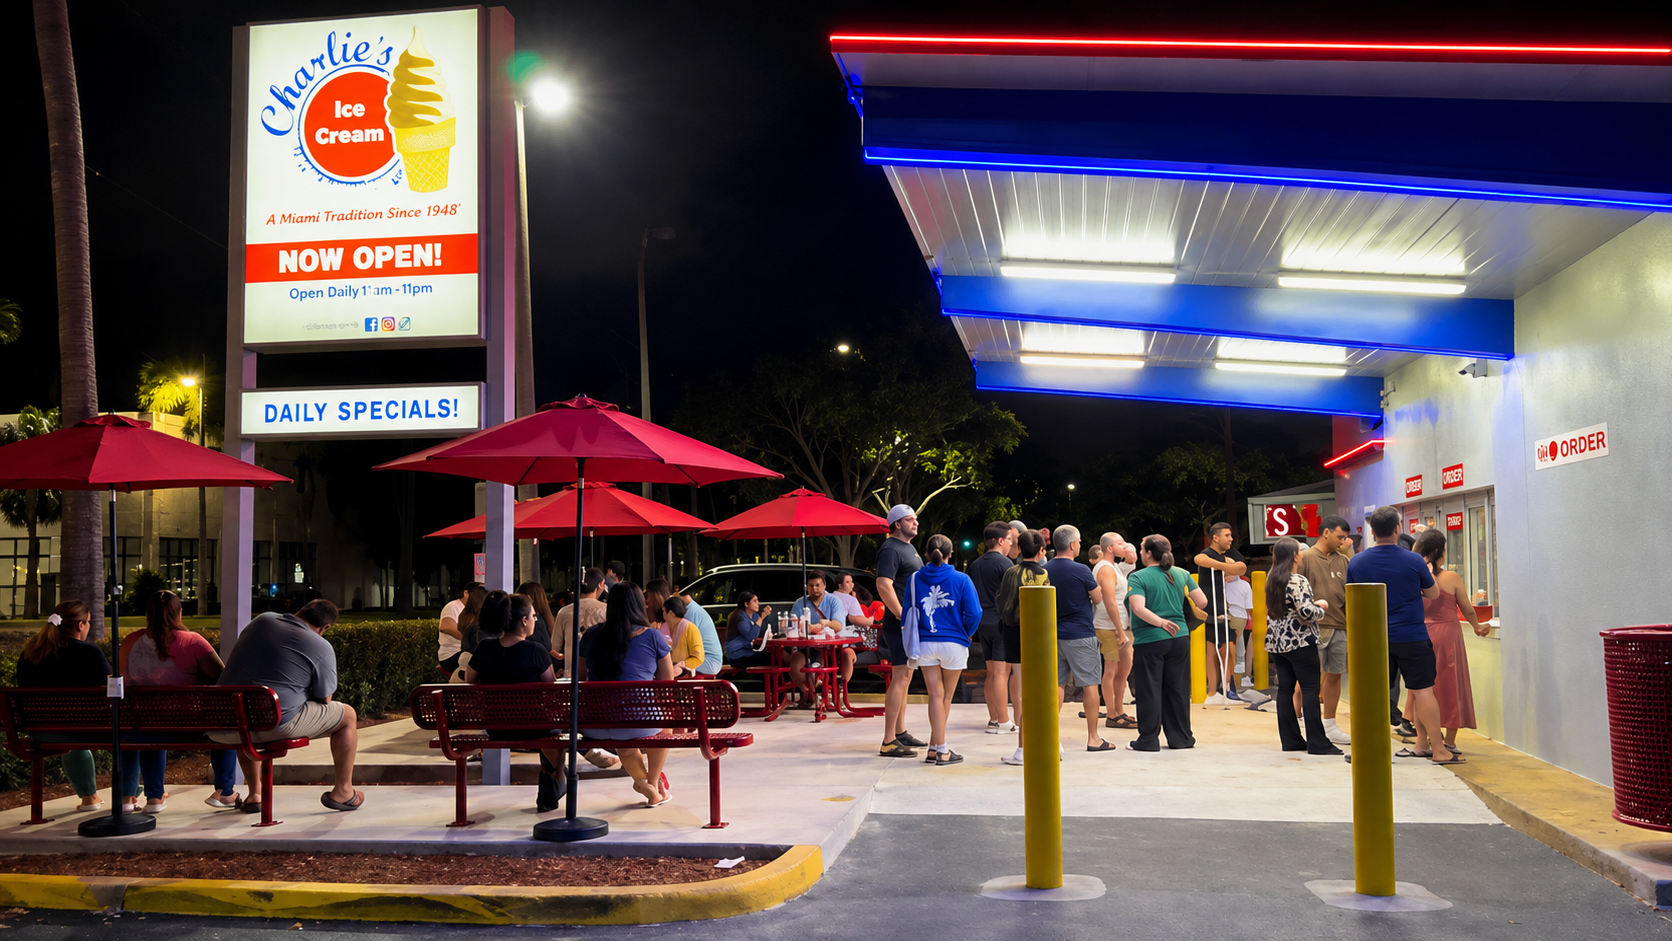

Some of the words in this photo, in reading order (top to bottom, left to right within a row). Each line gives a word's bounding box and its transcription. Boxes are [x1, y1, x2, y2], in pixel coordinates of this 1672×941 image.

[261, 30, 393, 136] Charlie's
[335, 100, 365, 118] Ice
[315, 127, 384, 145] Cream
[266, 214, 276, 226] A
[279, 211, 320, 225] Miami
[324, 208, 383, 222] Tradition
[387, 206, 421, 219] Since
[278, 247, 344, 273] NOW
[353, 243, 442, 270] OPEN!
[289, 288, 324, 302] Open
[328, 285, 360, 300] Daily
[402, 283, 433, 297] 11pm
[264, 402, 328, 423] DAILY
[338, 398, 459, 421] SPECIALS!
[1560, 431, 1606, 458] ORDER
